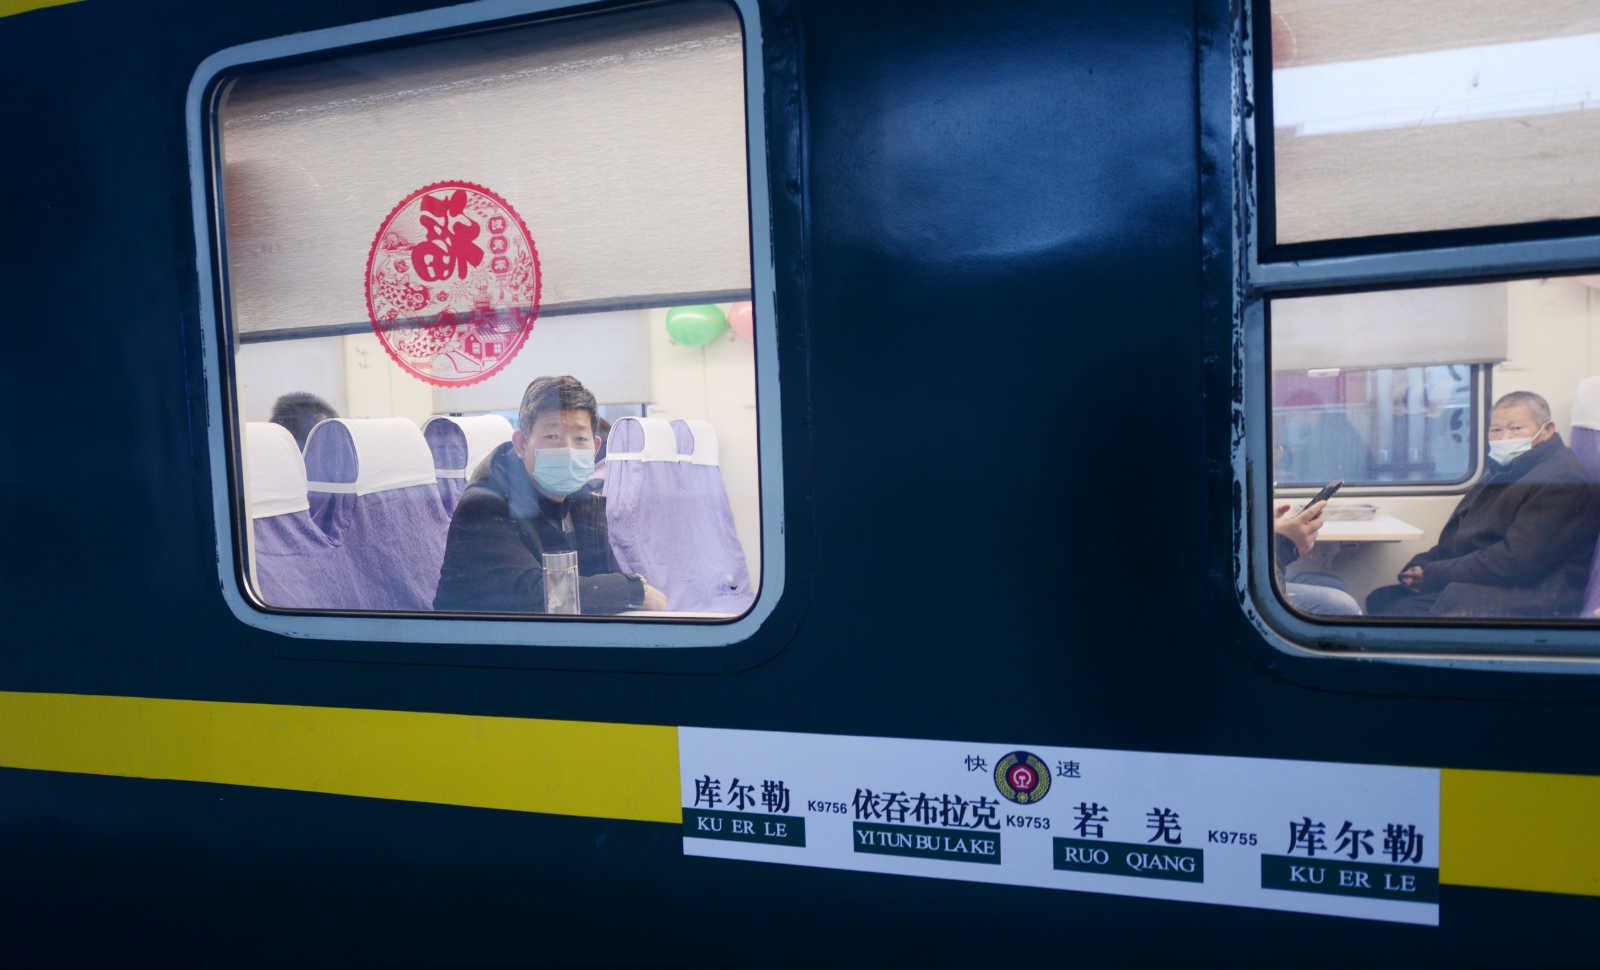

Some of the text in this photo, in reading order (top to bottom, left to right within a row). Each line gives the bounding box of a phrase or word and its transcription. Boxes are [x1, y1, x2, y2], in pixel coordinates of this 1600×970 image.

[965, 754, 1081, 778] 快 速
[694, 774, 791, 814] 库尔勒
[807, 800, 848, 814] K9756
[852, 788, 1001, 831] 依吞布拉克
[697, 816, 788, 837] KU ER LE
[1006, 814, 1051, 830] K9753
[1208, 829, 1258, 847] K9755
[1287, 816, 1425, 865] 库尔勒
[1065, 846, 1196, 873] RUO QIANG
[1289, 865, 1416, 892] KU ER LE
